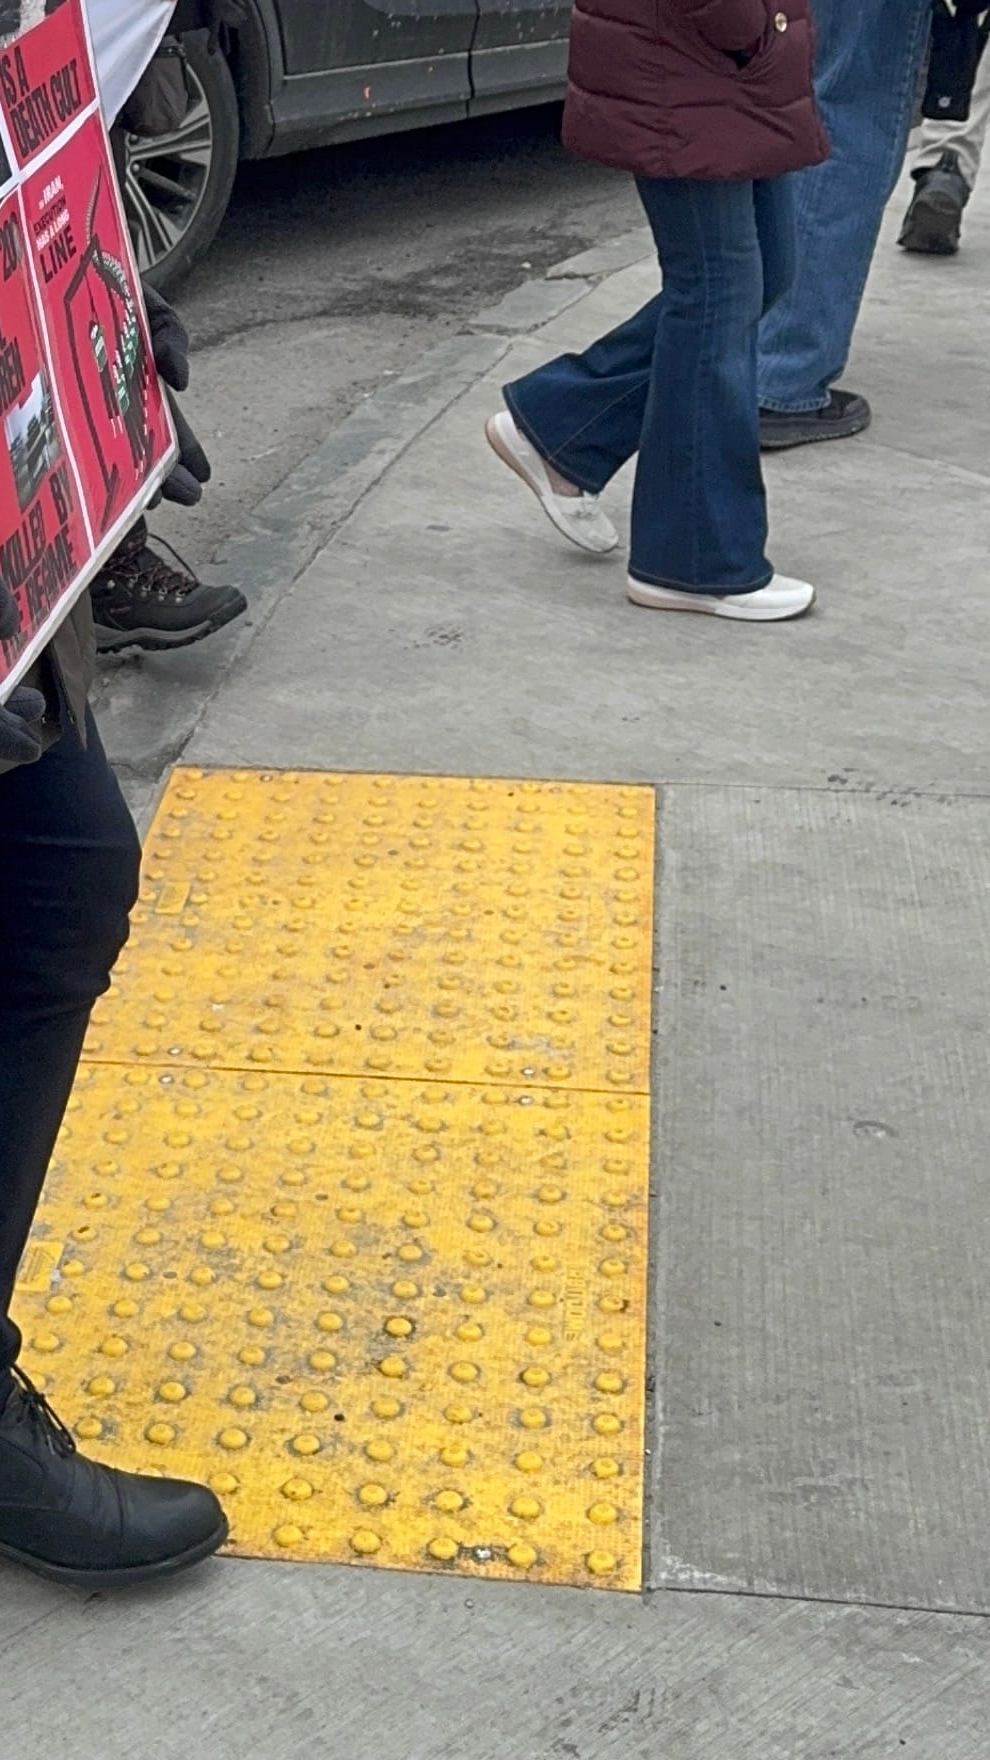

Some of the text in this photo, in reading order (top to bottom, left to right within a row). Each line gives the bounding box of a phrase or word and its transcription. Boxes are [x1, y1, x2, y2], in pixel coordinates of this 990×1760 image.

[13, 45, 30, 97] A
[10, 57, 82, 159] DEATH CULT
[39, 224, 77, 284] LINE
